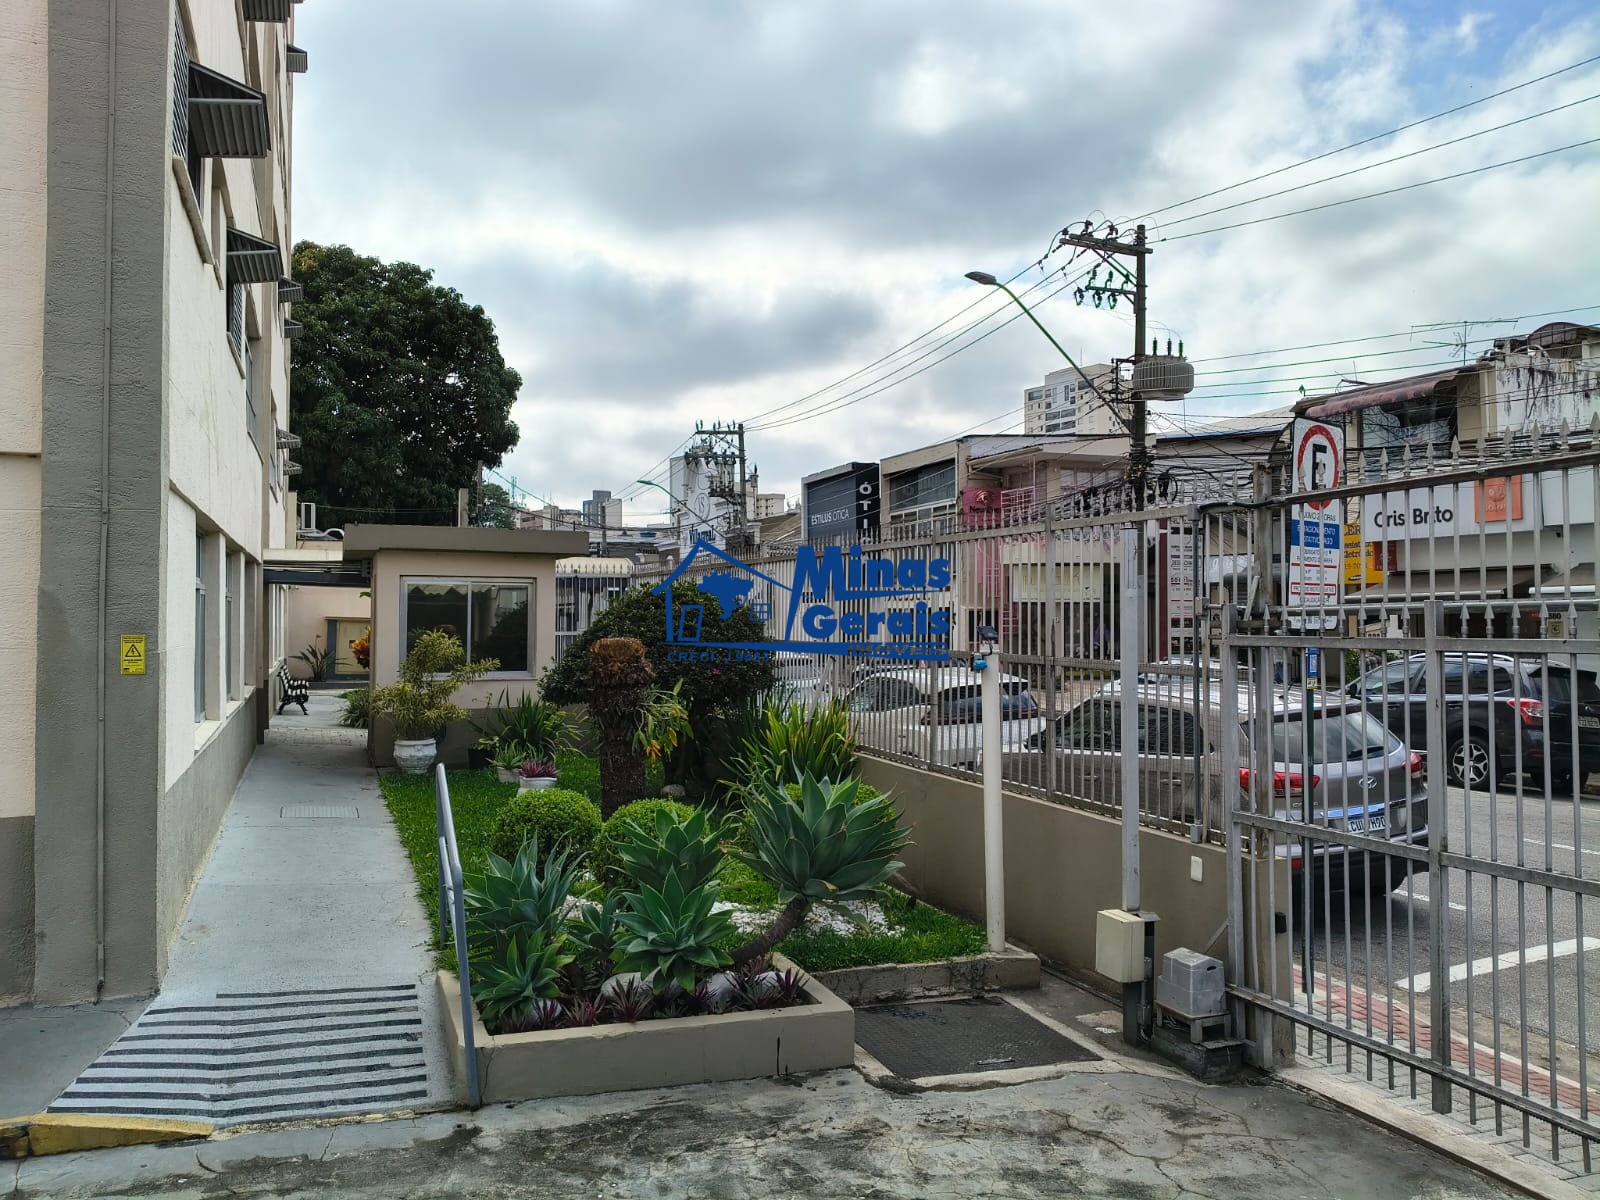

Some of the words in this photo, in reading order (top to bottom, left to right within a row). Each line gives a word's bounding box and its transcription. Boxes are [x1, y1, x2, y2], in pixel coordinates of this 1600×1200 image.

[811, 512, 832, 525] ESTILUS
[1374, 510, 1405, 527] Cris
[1413, 506, 1453, 525] Brto
